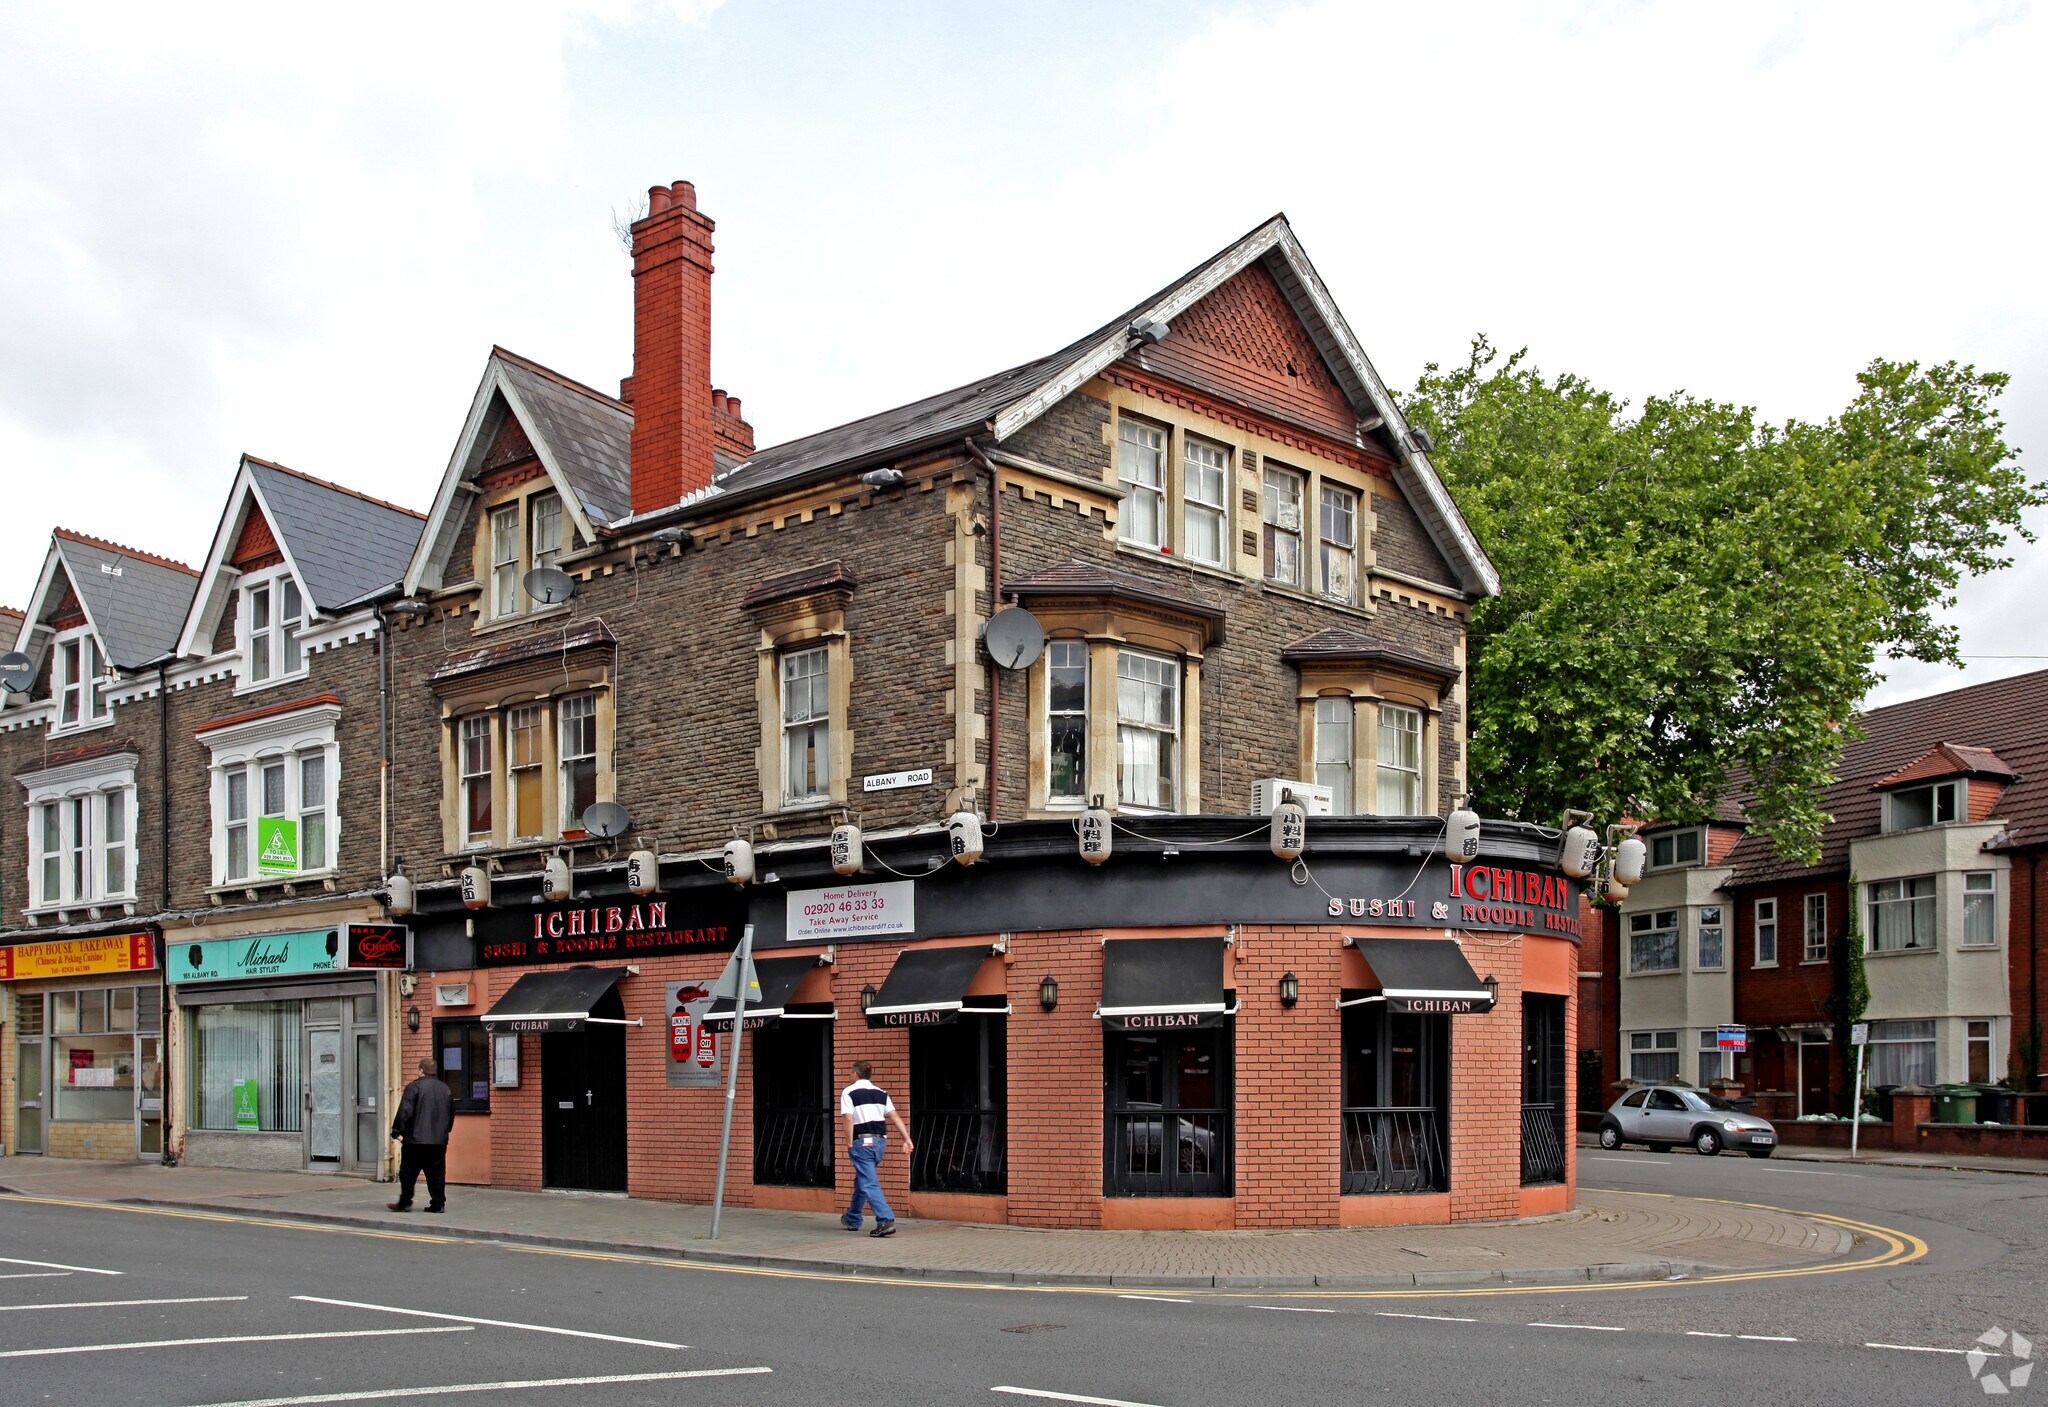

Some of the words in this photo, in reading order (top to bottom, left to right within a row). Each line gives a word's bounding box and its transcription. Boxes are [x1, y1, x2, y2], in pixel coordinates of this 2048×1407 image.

[866, 777, 896, 787] ALBANY
[907, 773, 929, 782] ROAD
[1083, 818, 1102, 852] 小料理
[1282, 813, 1301, 849] 小料理
[1449, 864, 1568, 910] ICHIBAN
[823, 892, 845, 901] Home
[848, 890, 877, 900] Delivery
[804, 903, 835, 916] 02920
[839, 901, 852, 912] 46
[855, 900, 868, 911] 33
[872, 898, 885, 909] 33
[1328, 897, 1416, 918] SUSHI
[1432, 902, 1449, 919] &
[534, 902, 667, 939] ICHIBAN
[829, 916, 849, 925] Away
[852, 913, 879, 922] Service
[1463, 904, 1534, 927] NOODLE
[814, 926, 831, 934] Online
[833, 922, 904, 933] www.ichibancardiff.co.uk
[18, 946, 44, 957] HAPPY
[46, 942, 73, 955] HOUSE
[79, 937, 125, 952] TAKEAWAY
[362, 942, 400, 952] ICHIBAN
[484, 942, 527, 958] SUSHI
[537, 942, 549, 954] &
[556, 936, 617, 953] NOODLE
[626, 927, 727, 949] RESTAURANT
[35, 956, 57, 967] (Chinese
[58, 956, 63, 964] &
[64, 955, 82, 964] Peking
[83, 952, 103, 961] Cuisine
[313, 962, 332, 970] PHONE
[191, 971, 210, 979] ALBANY
[259, 966, 280, 974] STYLIST
[1407, 1000, 1471, 1012] ICHIBAN
[510, 1021, 549, 1030] ICHIBAN
[717, 1018, 764, 1030] ICHBAN
[884, 1011, 940, 1026] ICHIBAN
[1124, 1014, 1199, 1028] ICHIBAN
